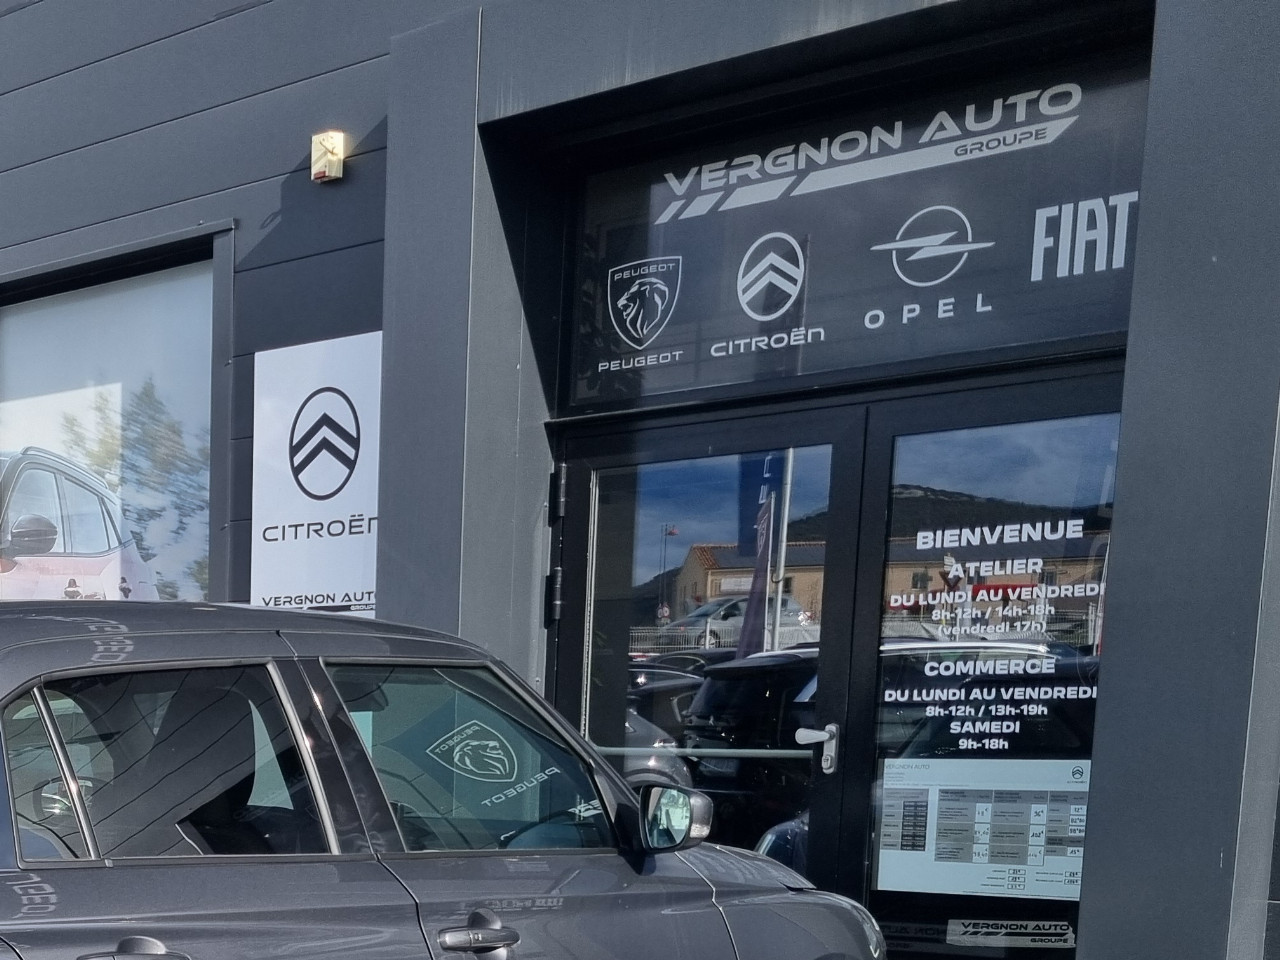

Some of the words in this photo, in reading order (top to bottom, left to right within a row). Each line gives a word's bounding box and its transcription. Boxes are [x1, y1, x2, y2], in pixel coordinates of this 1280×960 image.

[664, 120, 903, 196] VERGNON
[919, 83, 1082, 143] AUTO
[954, 128, 1048, 157] GROUPE
[1031, 192, 1139, 282] FIAT
[614, 262, 676, 280] PEUGEOT
[864, 293, 992, 329] OPEL
[598, 350, 683, 372] PEUGEOT
[916, 519, 1085, 550] BIENVENUE
[948, 558, 1043, 579] ATELIER
[262, 592, 336, 607] VERGNON
[340, 590, 376, 602] AUT
[890, 595, 914, 607] DU
[919, 591, 971, 605] LUNDI
[976, 588, 1003, 602] AU
[1007, 583, 1105, 600] VENDREDI
[931, 609, 982, 621] 8h-12h
[995, 604, 1055, 618] 14h-18h
[937, 623, 1010, 636] (vendredi
[1014, 621, 1047, 633] 17h)
[924, 659, 1056, 677] COMMERCE
[884, 690, 909, 702] DU
[913, 689, 965, 701] LUNDI
[969, 689, 996, 701] AU
[1000, 686, 1098, 700] VENDREDI
[925, 705, 975, 717] 8h-12h
[988, 704, 1048, 716] 13h-19h
[949, 721, 1020, 734] SAMEDI
[958, 738, 1009, 751] 9h-18h
[961, 922, 1028, 932] VERGNON
[1032, 923, 1070, 932] AUTO
